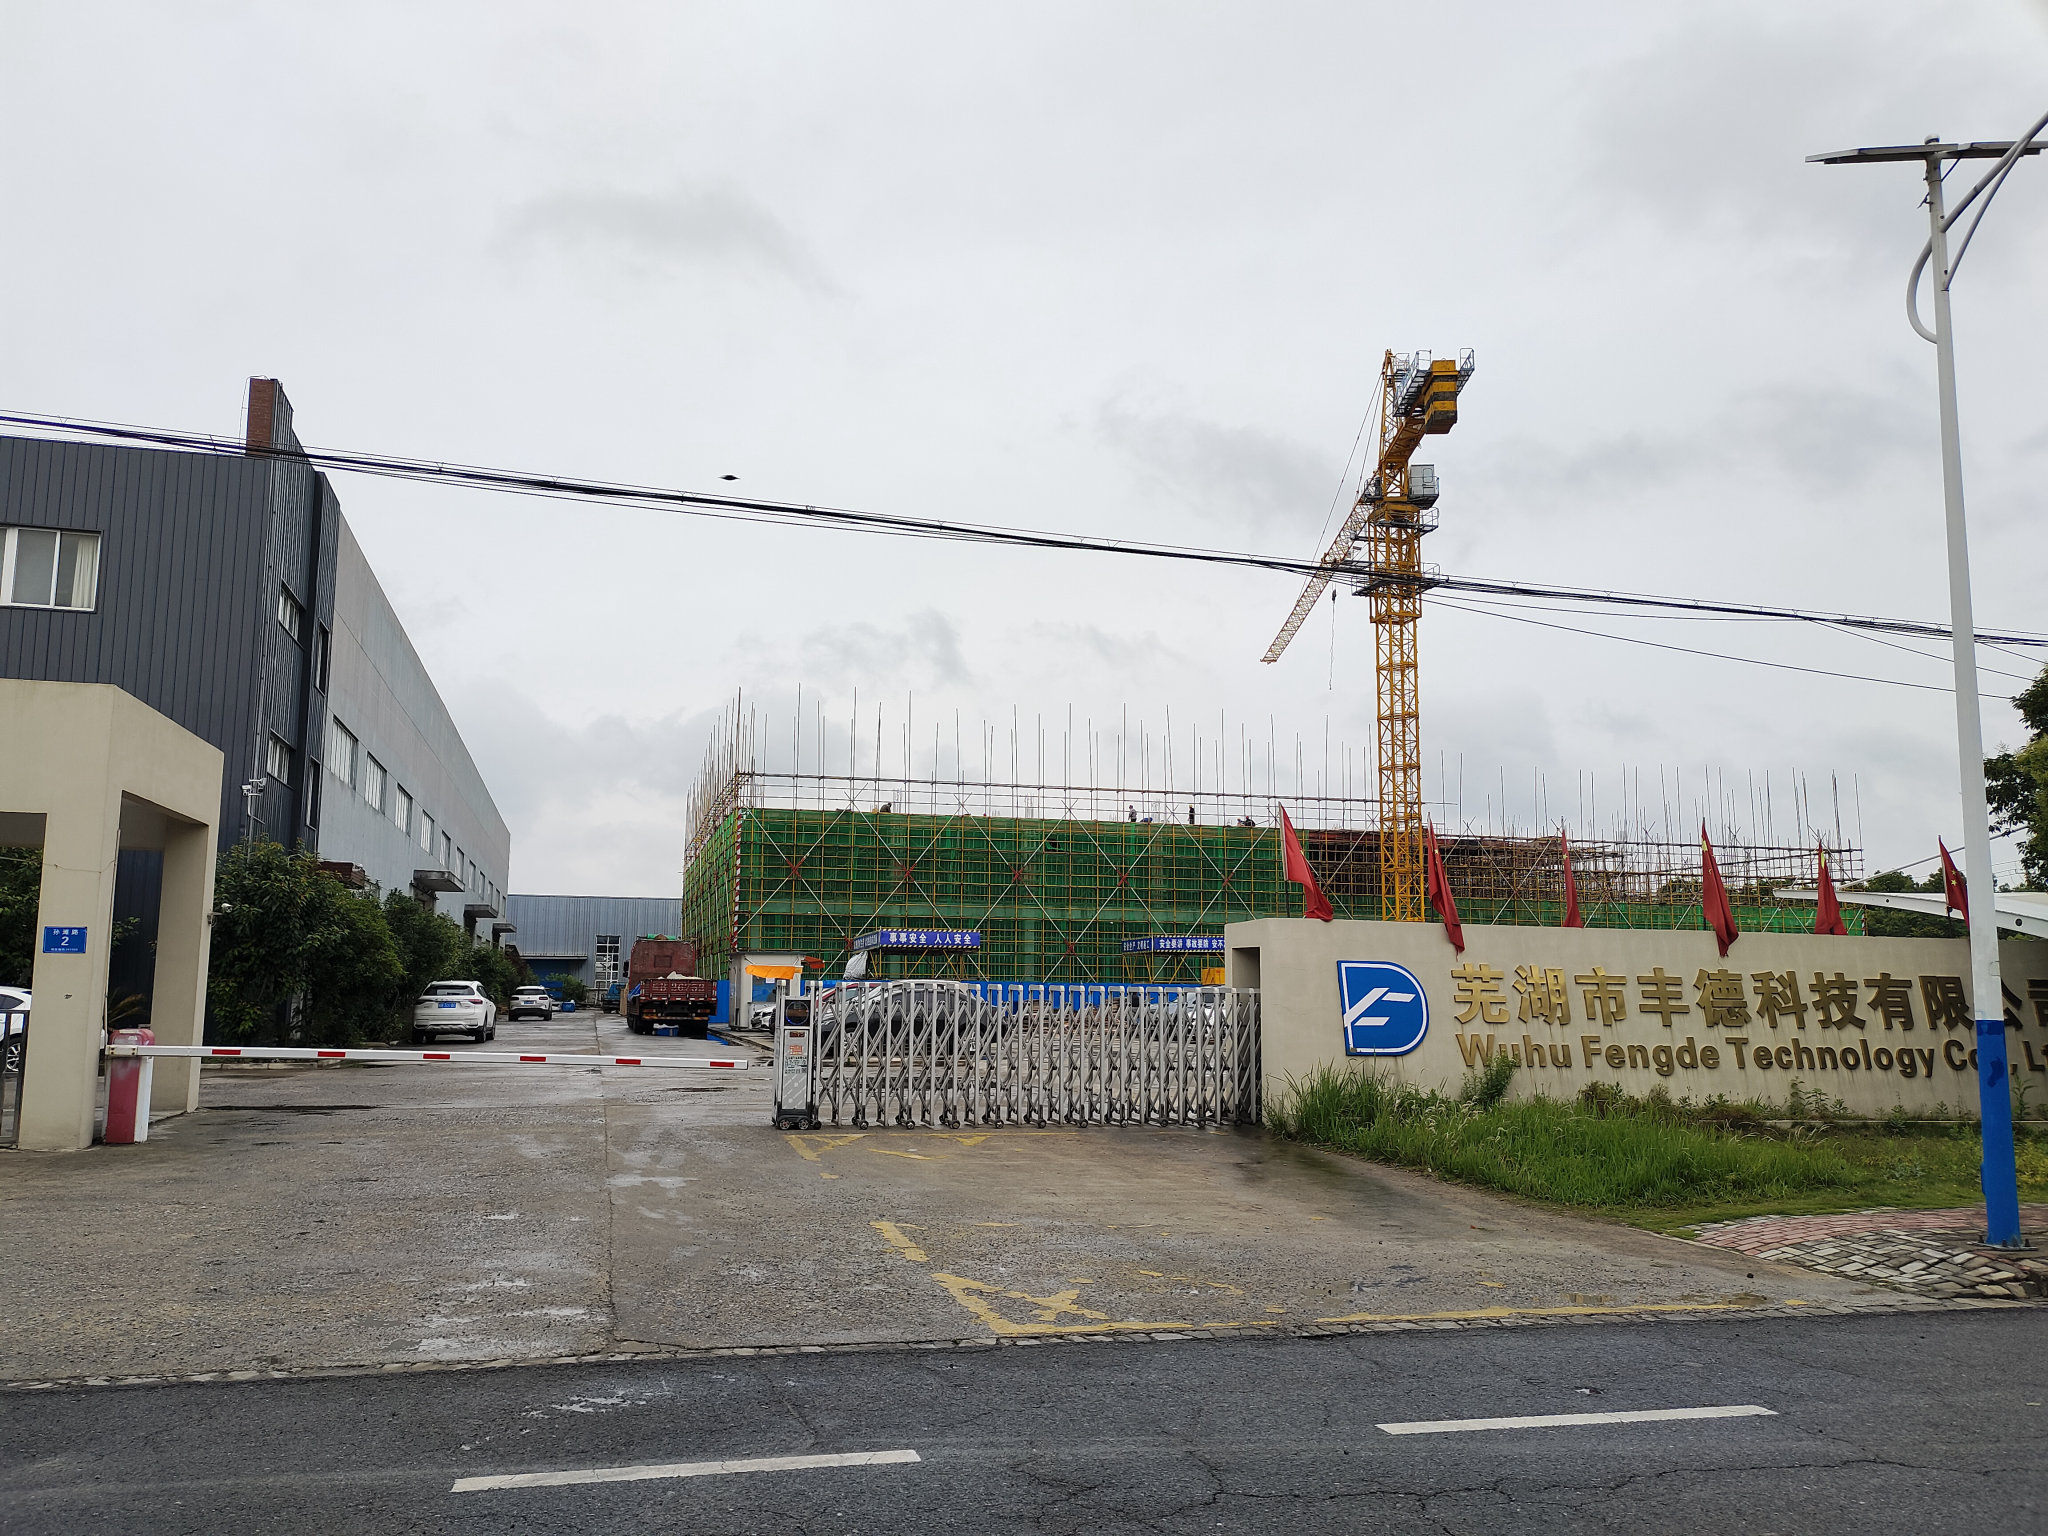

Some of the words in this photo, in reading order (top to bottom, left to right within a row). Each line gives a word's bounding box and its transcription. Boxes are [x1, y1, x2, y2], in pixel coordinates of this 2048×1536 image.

[61, 936, 69, 946] 2
[889, 932, 927, 944] 事事安全
[934, 933, 972, 945] 人人安全
[1212, 939, 1225, 949] 安不
[1455, 1033, 1573, 1068] Wuhu
[1580, 1035, 1720, 1077] Fengde
[1725, 1036, 1935, 1078] Technology
